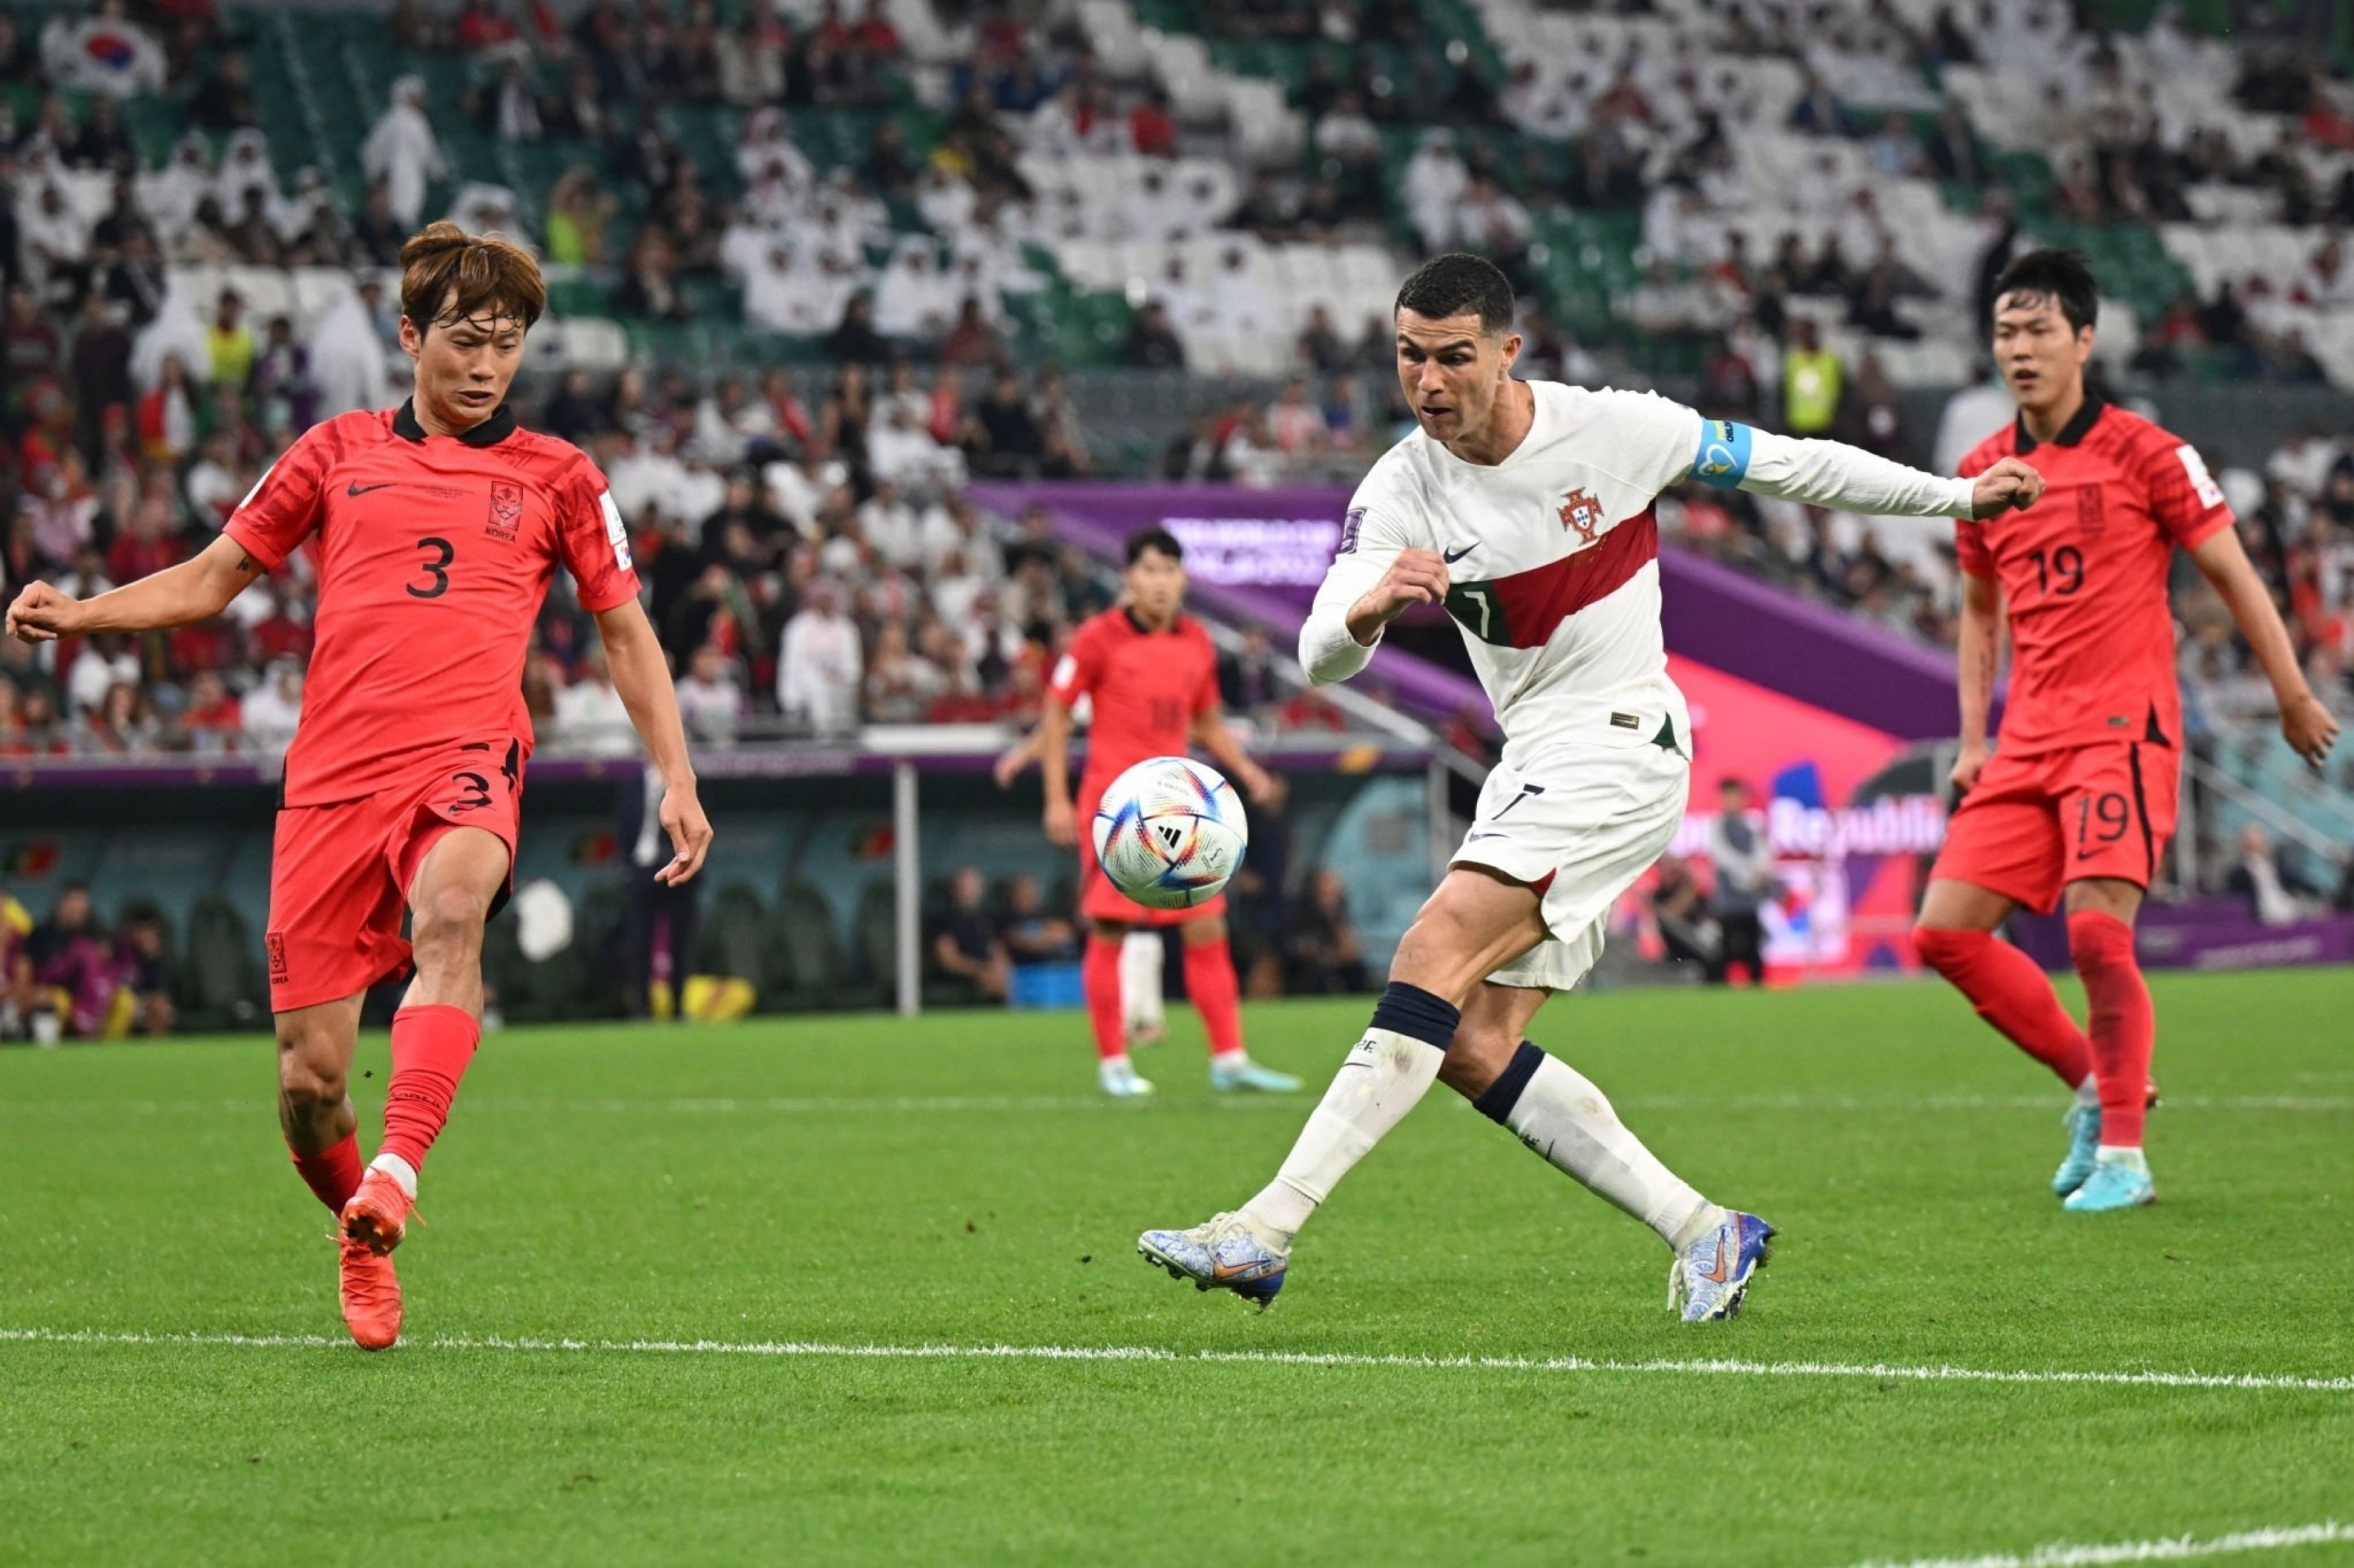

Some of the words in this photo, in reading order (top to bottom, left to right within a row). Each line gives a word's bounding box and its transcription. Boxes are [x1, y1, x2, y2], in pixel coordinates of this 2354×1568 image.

[485, 525, 516, 543] KOREA
[406, 536, 455, 599] 3
[2028, 543, 2084, 597] 19
[1462, 590, 1490, 640] 7
[447, 772, 493, 816] 3
[1491, 782, 1545, 821] 7
[2076, 792, 2129, 843] 19
